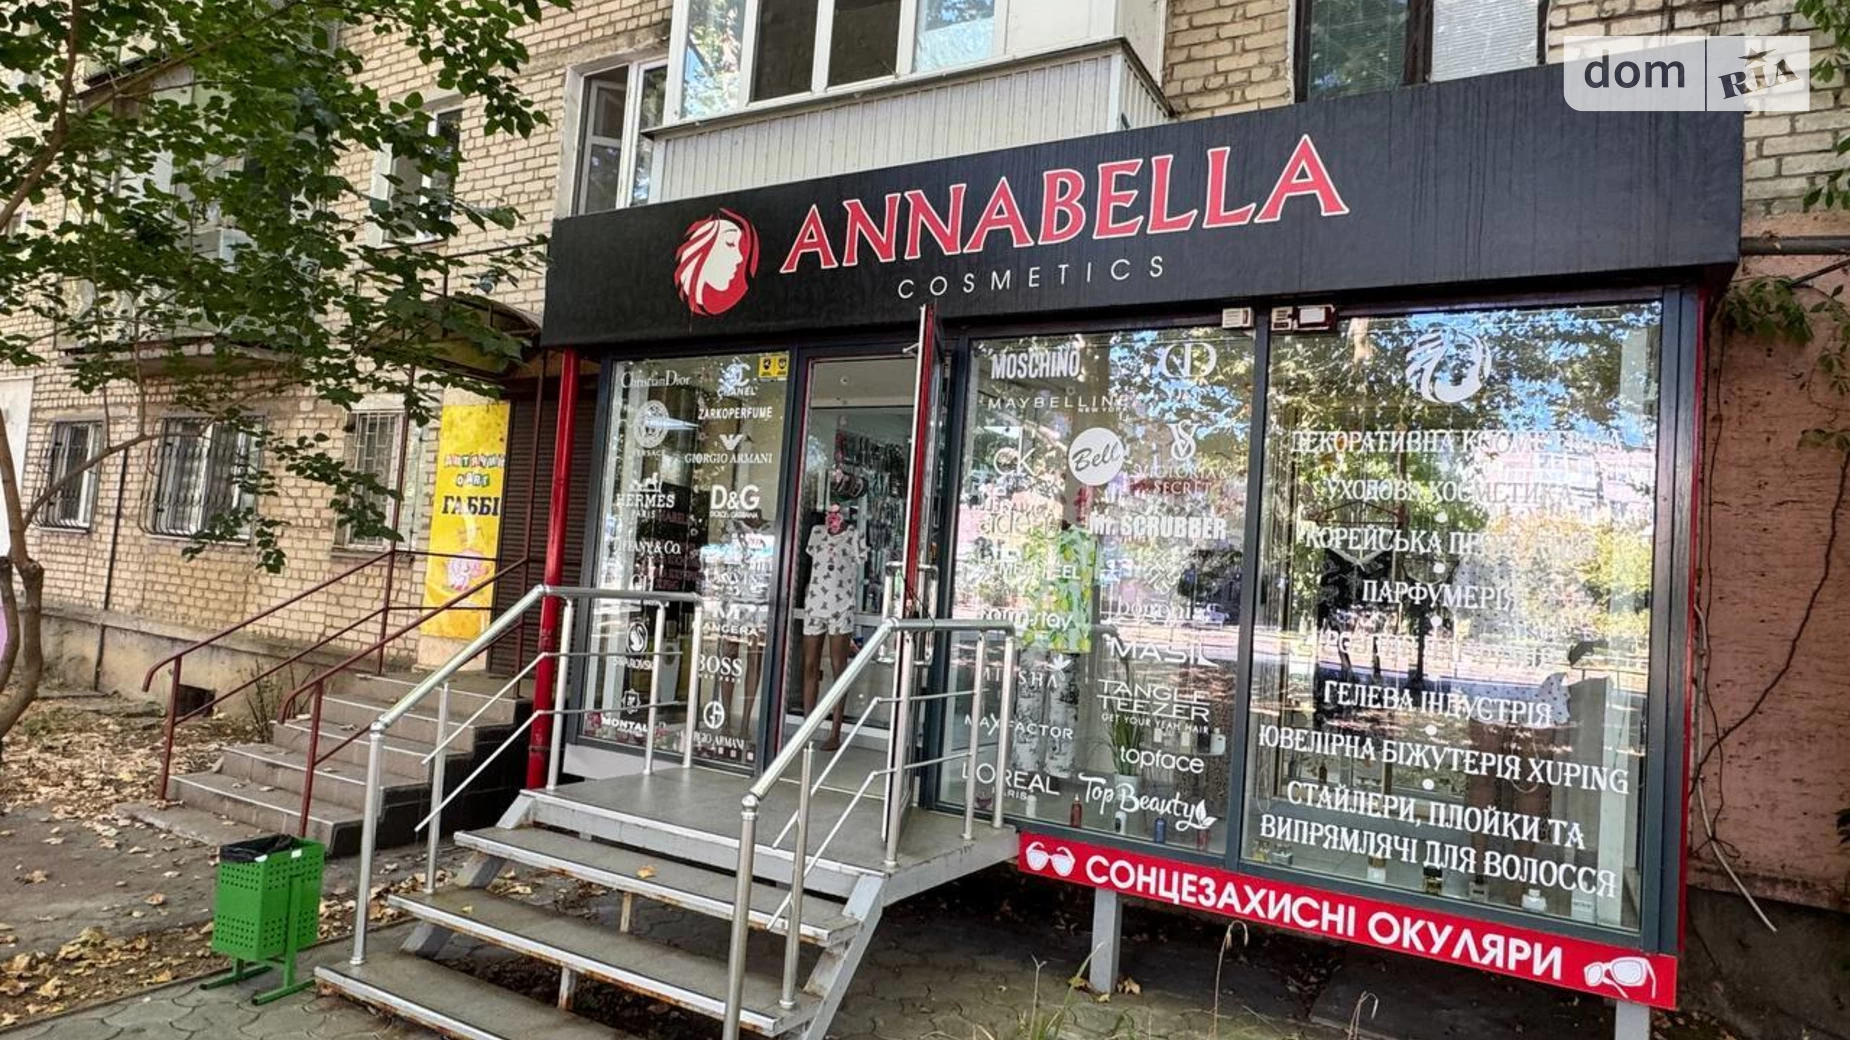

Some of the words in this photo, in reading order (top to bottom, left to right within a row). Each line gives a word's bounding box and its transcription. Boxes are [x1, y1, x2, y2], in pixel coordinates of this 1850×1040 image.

[779, 133, 1350, 275] ANNABELLA
[897, 255, 1164, 299] COSMETICS
[665, 369, 692, 387] Dior
[990, 351, 1080, 379] MOSCHINO
[698, 405, 773, 420] ZARKOPERFUME
[987, 395, 1127, 410] MAYBELLINE
[1291, 429, 1453, 453] ДЕКОРАТИВНА
[685, 452, 728, 464] GIORGIO
[729, 452, 773, 464] ARMANI
[1071, 442, 1121, 473] Bell
[441, 495, 500, 517] ГАББІ
[615, 494, 675, 509] HERMES
[710, 483, 760, 510] D&G
[1120, 514, 1227, 540] SCRUBBER
[1304, 525, 1442, 555] КОРЕЙСЬКА
[1361, 580, 1517, 609] ПАРФУМЕРІЯ
[701, 621, 760, 638] ANCERA
[698, 654, 743, 677] BOSS
[1097, 678, 1211, 706] TANGLE
[1323, 679, 1414, 711] ГЕЛЕВА
[1421, 686, 1554, 727] ІНДУСТРІЯ
[1096, 694, 1210, 722] TEEZER
[1101, 712, 1120, 722] GET
[1125, 716, 1151, 727] YOUR
[600, 714, 649, 733] MONTAL
[1120, 745, 1205, 775] topface
[1258, 724, 1375, 762] ЮВЕЛІРНА
[1381, 742, 1522, 781] БІЖУТЕРІЯ
[1526, 757, 1630, 795] XUPING
[1078, 772, 1115, 815] Top
[1119, 784, 1206, 831] Beauty
[1287, 780, 1421, 828] СТАЙЛЕРИ,
[1428, 801, 1541, 846] ПЛОЙКИ
[1548, 819, 1586, 850] ТА
[1260, 814, 1419, 864] ВИПРЯМЛЯЧІ
[1424, 840, 1477, 876] ДЛЯ
[1483, 851, 1618, 899] ВОЛОССЯ
[1086, 854, 1356, 937] СОНЦЕЗАХИСНІ
[1367, 911, 1563, 981] ОКУЛЯРИ
